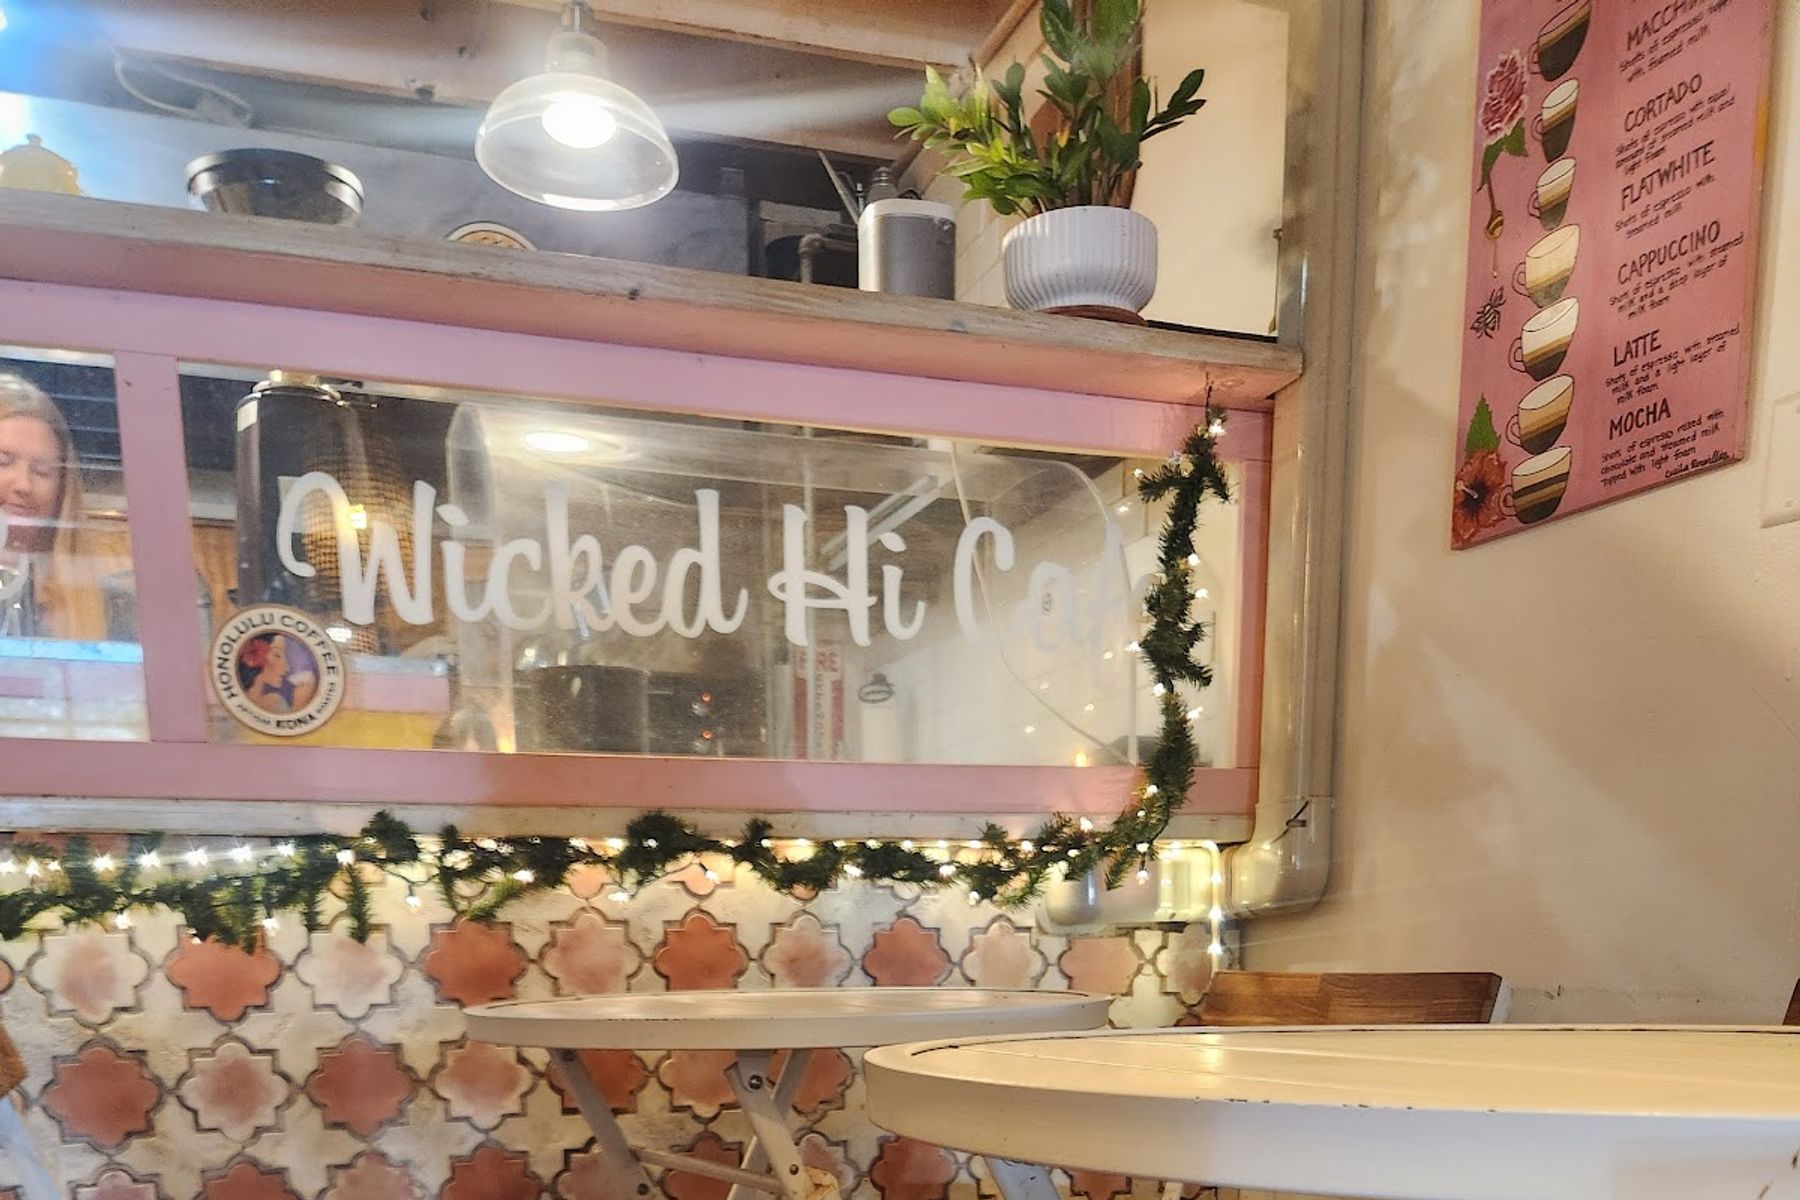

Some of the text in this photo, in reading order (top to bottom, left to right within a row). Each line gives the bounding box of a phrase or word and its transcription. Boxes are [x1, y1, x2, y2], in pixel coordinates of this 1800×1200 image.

[1624, 73, 1702, 133] CORTADO
[1621, 139, 1716, 212] FLATWHITE
[1617, 220, 1721, 285] CAPPUCCINO
[1613, 328, 1662, 367] LATTE
[1609, 397, 1671, 441] MOCHA
[277, 471, 1160, 672] Wicked Hi Caf
[216, 612, 275, 700] HONOLULU
[280, 614, 338, 677] COFFEE
